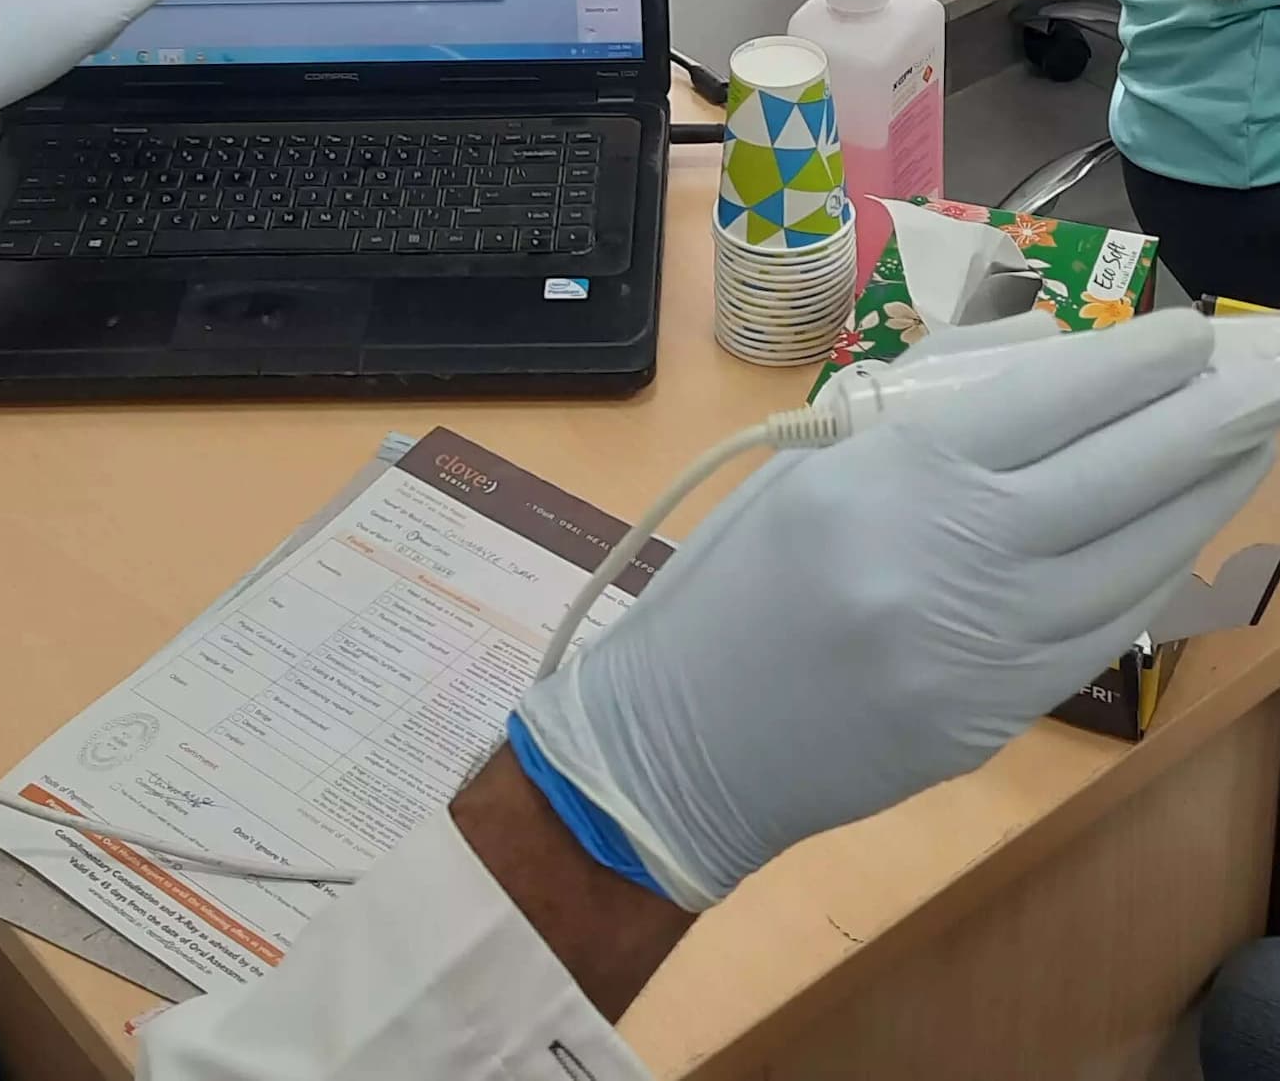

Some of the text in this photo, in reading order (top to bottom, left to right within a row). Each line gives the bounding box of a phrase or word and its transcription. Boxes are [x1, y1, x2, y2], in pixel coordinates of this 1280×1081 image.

[1094, 241, 1129, 289] Eco Soft
[586, 535, 610, 551] HEAL
[627, 558, 657, 573] REPO
[232, 826, 255, 844] Don't
[54, 829, 110, 873] Complimentary
[112, 870, 159, 905] Consultation
[158, 905, 176, 917] and
[208, 939, 240, 960] advised
[237, 957, 250, 968] by
[249, 965, 264, 977] the
[69, 857, 89, 874] Valid
[87, 871, 100, 882] for
[110, 888, 128, 903] days
[126, 899, 147, 915] from
[146, 914, 161, 926] the
[160, 925, 179, 938] date
[178, 936, 190, 945] of
[188, 942, 208, 957] Oral
[206, 955, 246, 983] Assessme
